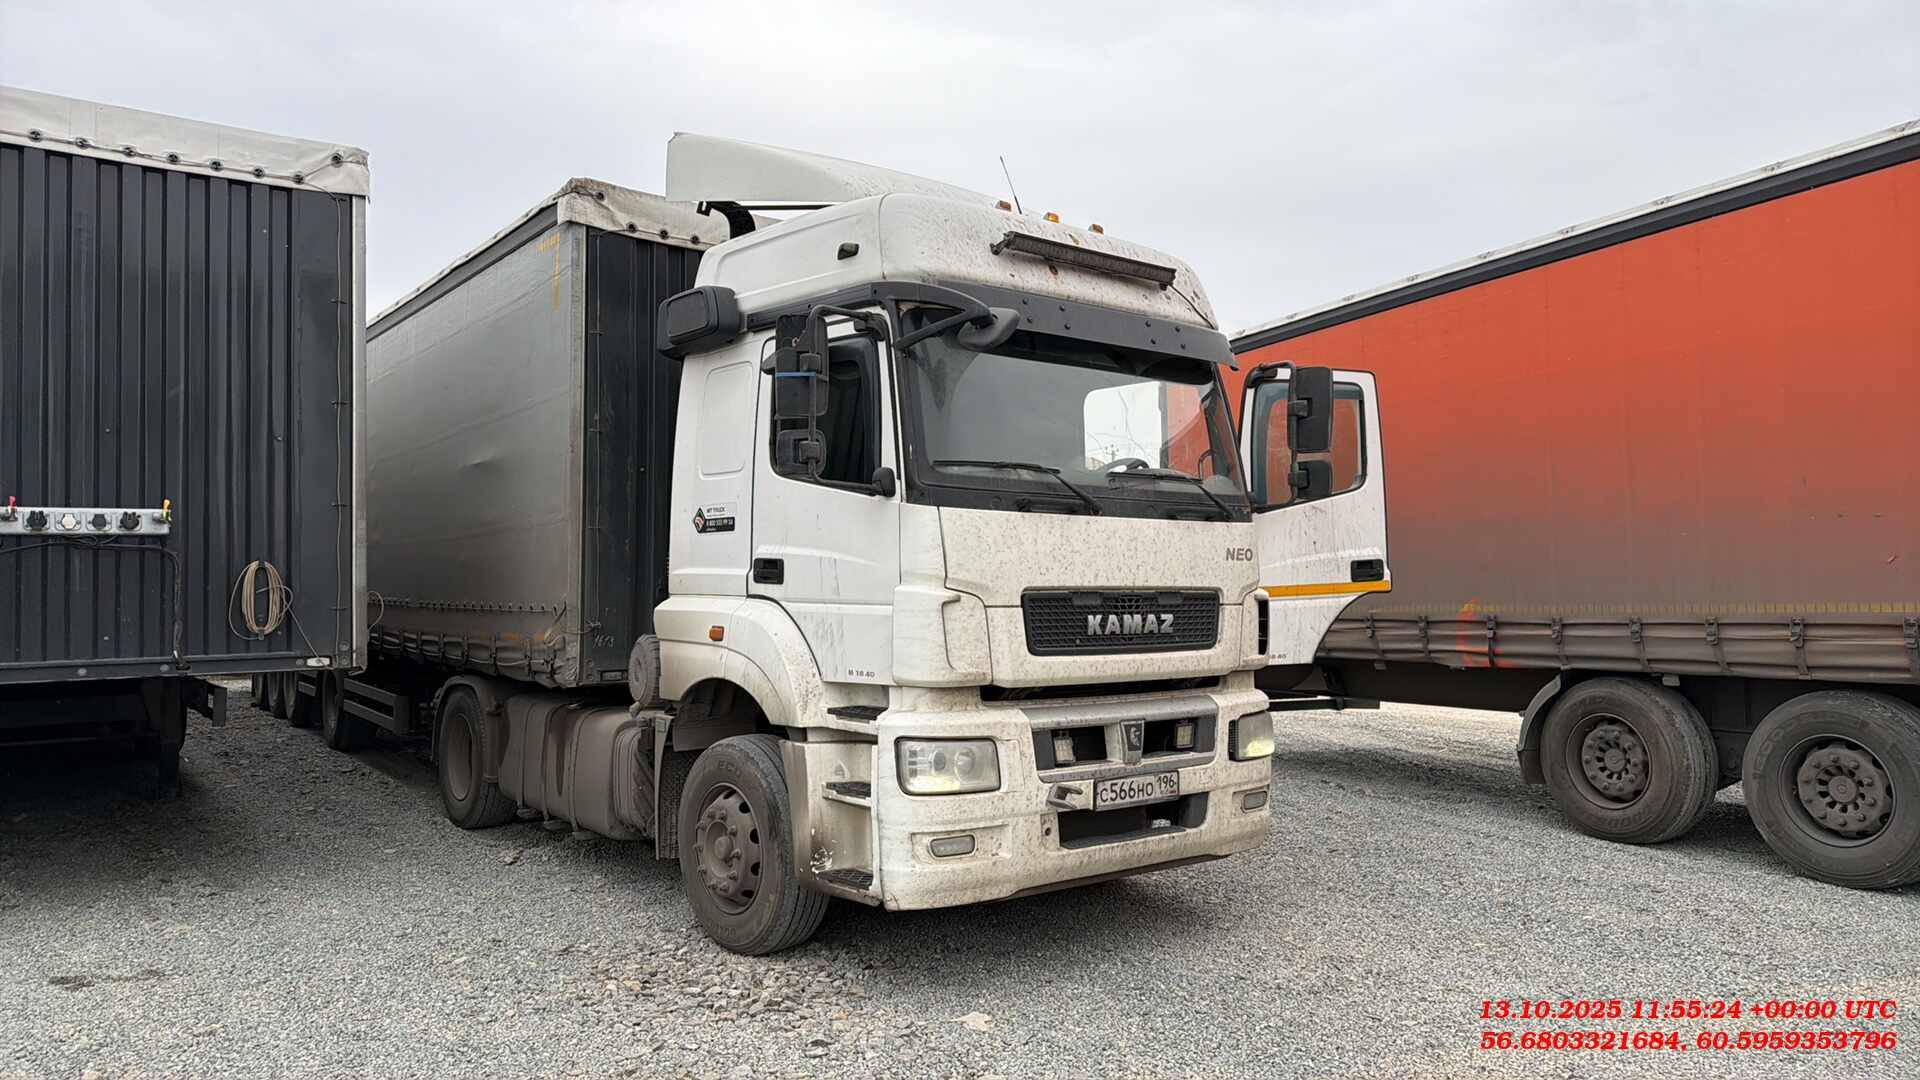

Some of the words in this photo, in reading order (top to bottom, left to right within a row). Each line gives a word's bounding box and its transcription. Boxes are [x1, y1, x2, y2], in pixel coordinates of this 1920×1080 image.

[1225, 547, 1253, 561] NEO
[1086, 613, 1175, 636] KAMAZ
[1157, 774, 1175, 790] 196
